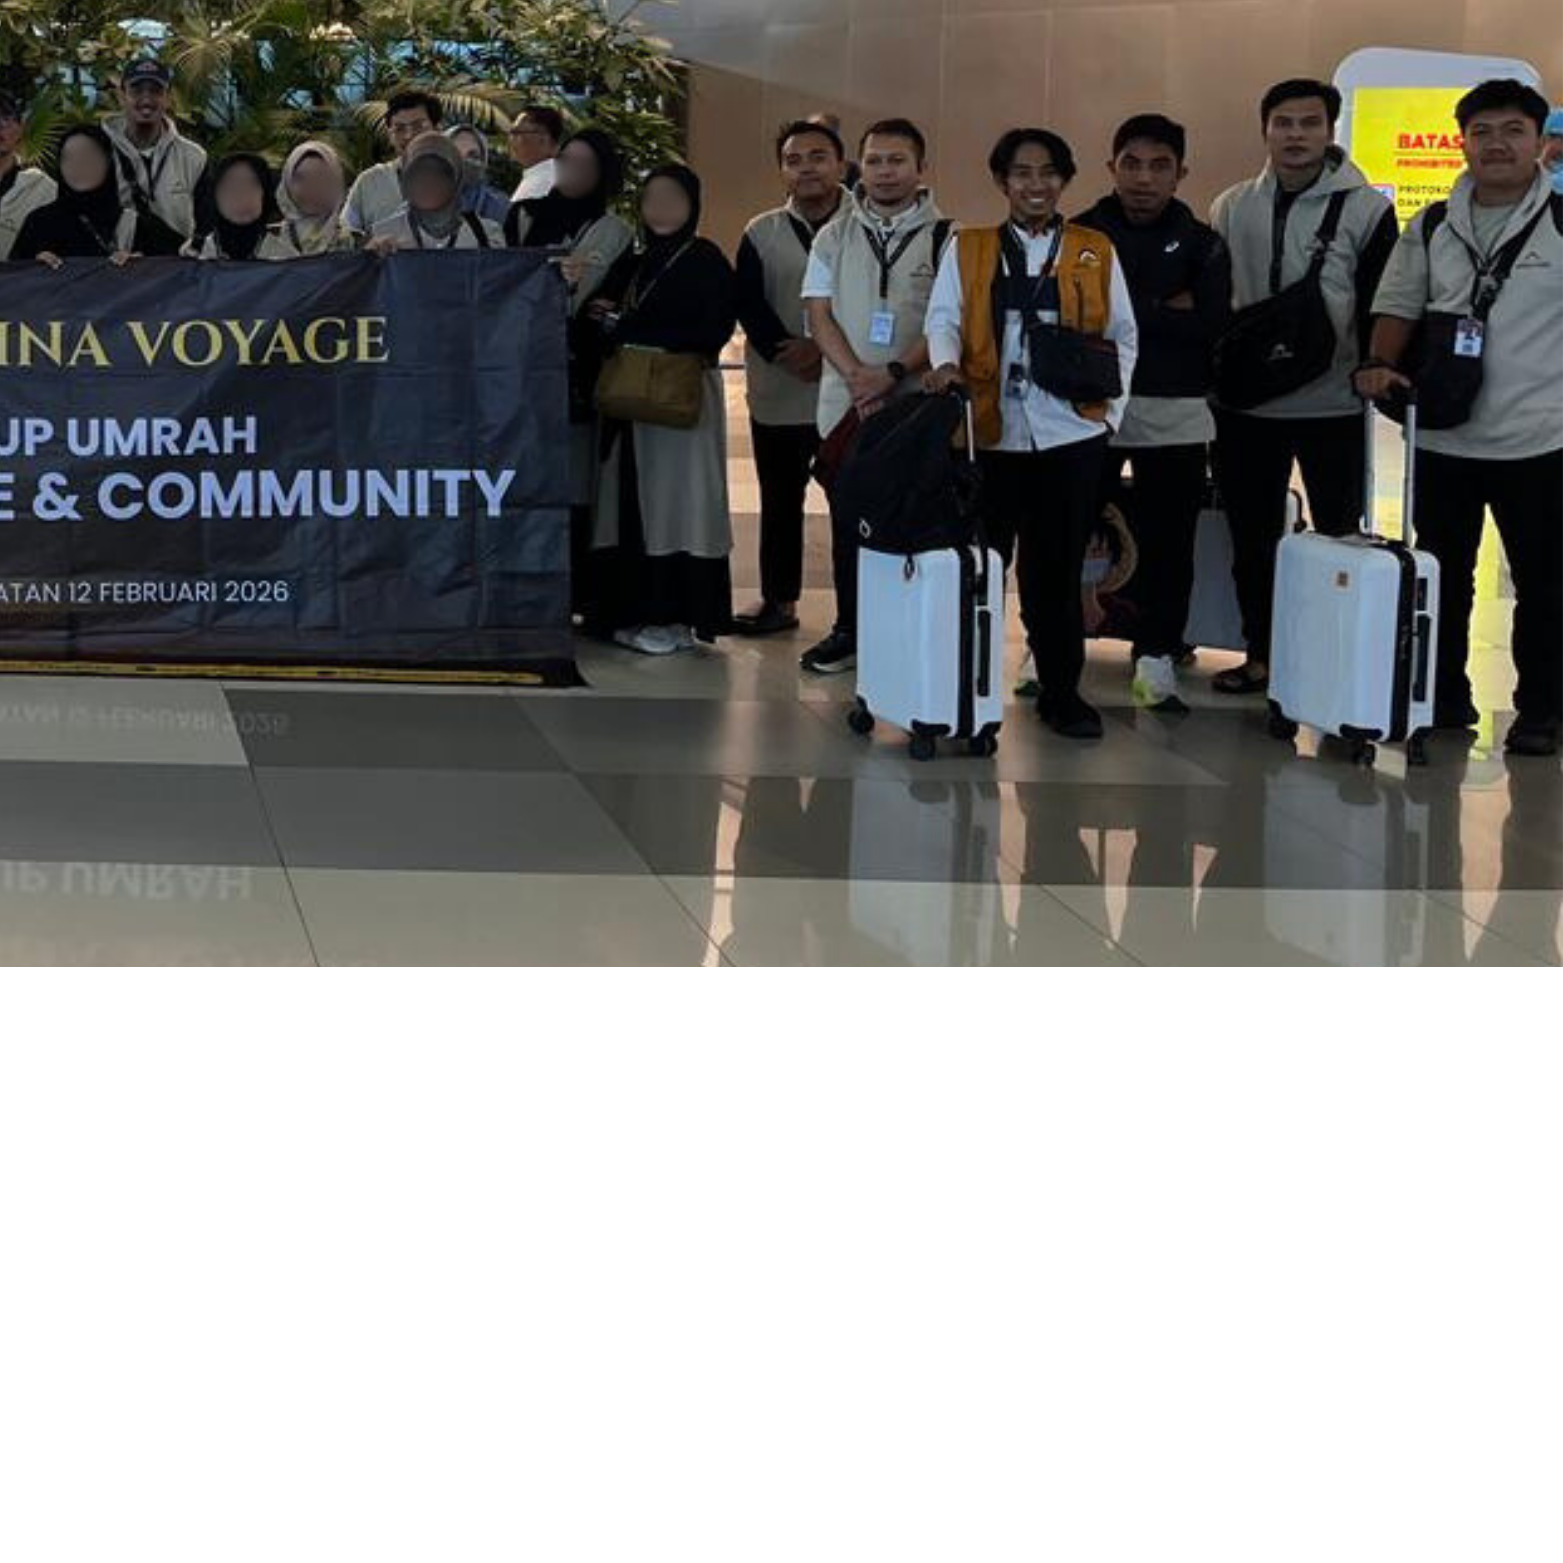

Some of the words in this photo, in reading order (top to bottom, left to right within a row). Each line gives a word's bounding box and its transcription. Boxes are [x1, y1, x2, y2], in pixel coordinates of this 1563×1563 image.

[126, 316, 389, 367] VOYAGE
[66, 415, 258, 457] UMRAH
[32, 470, 82, 522] &
[96, 468, 516, 521] COMMUNITY
[69, 582, 91, 603] 12
[99, 581, 218, 603] FEBRUARI
[224, 579, 290, 603] 2026
